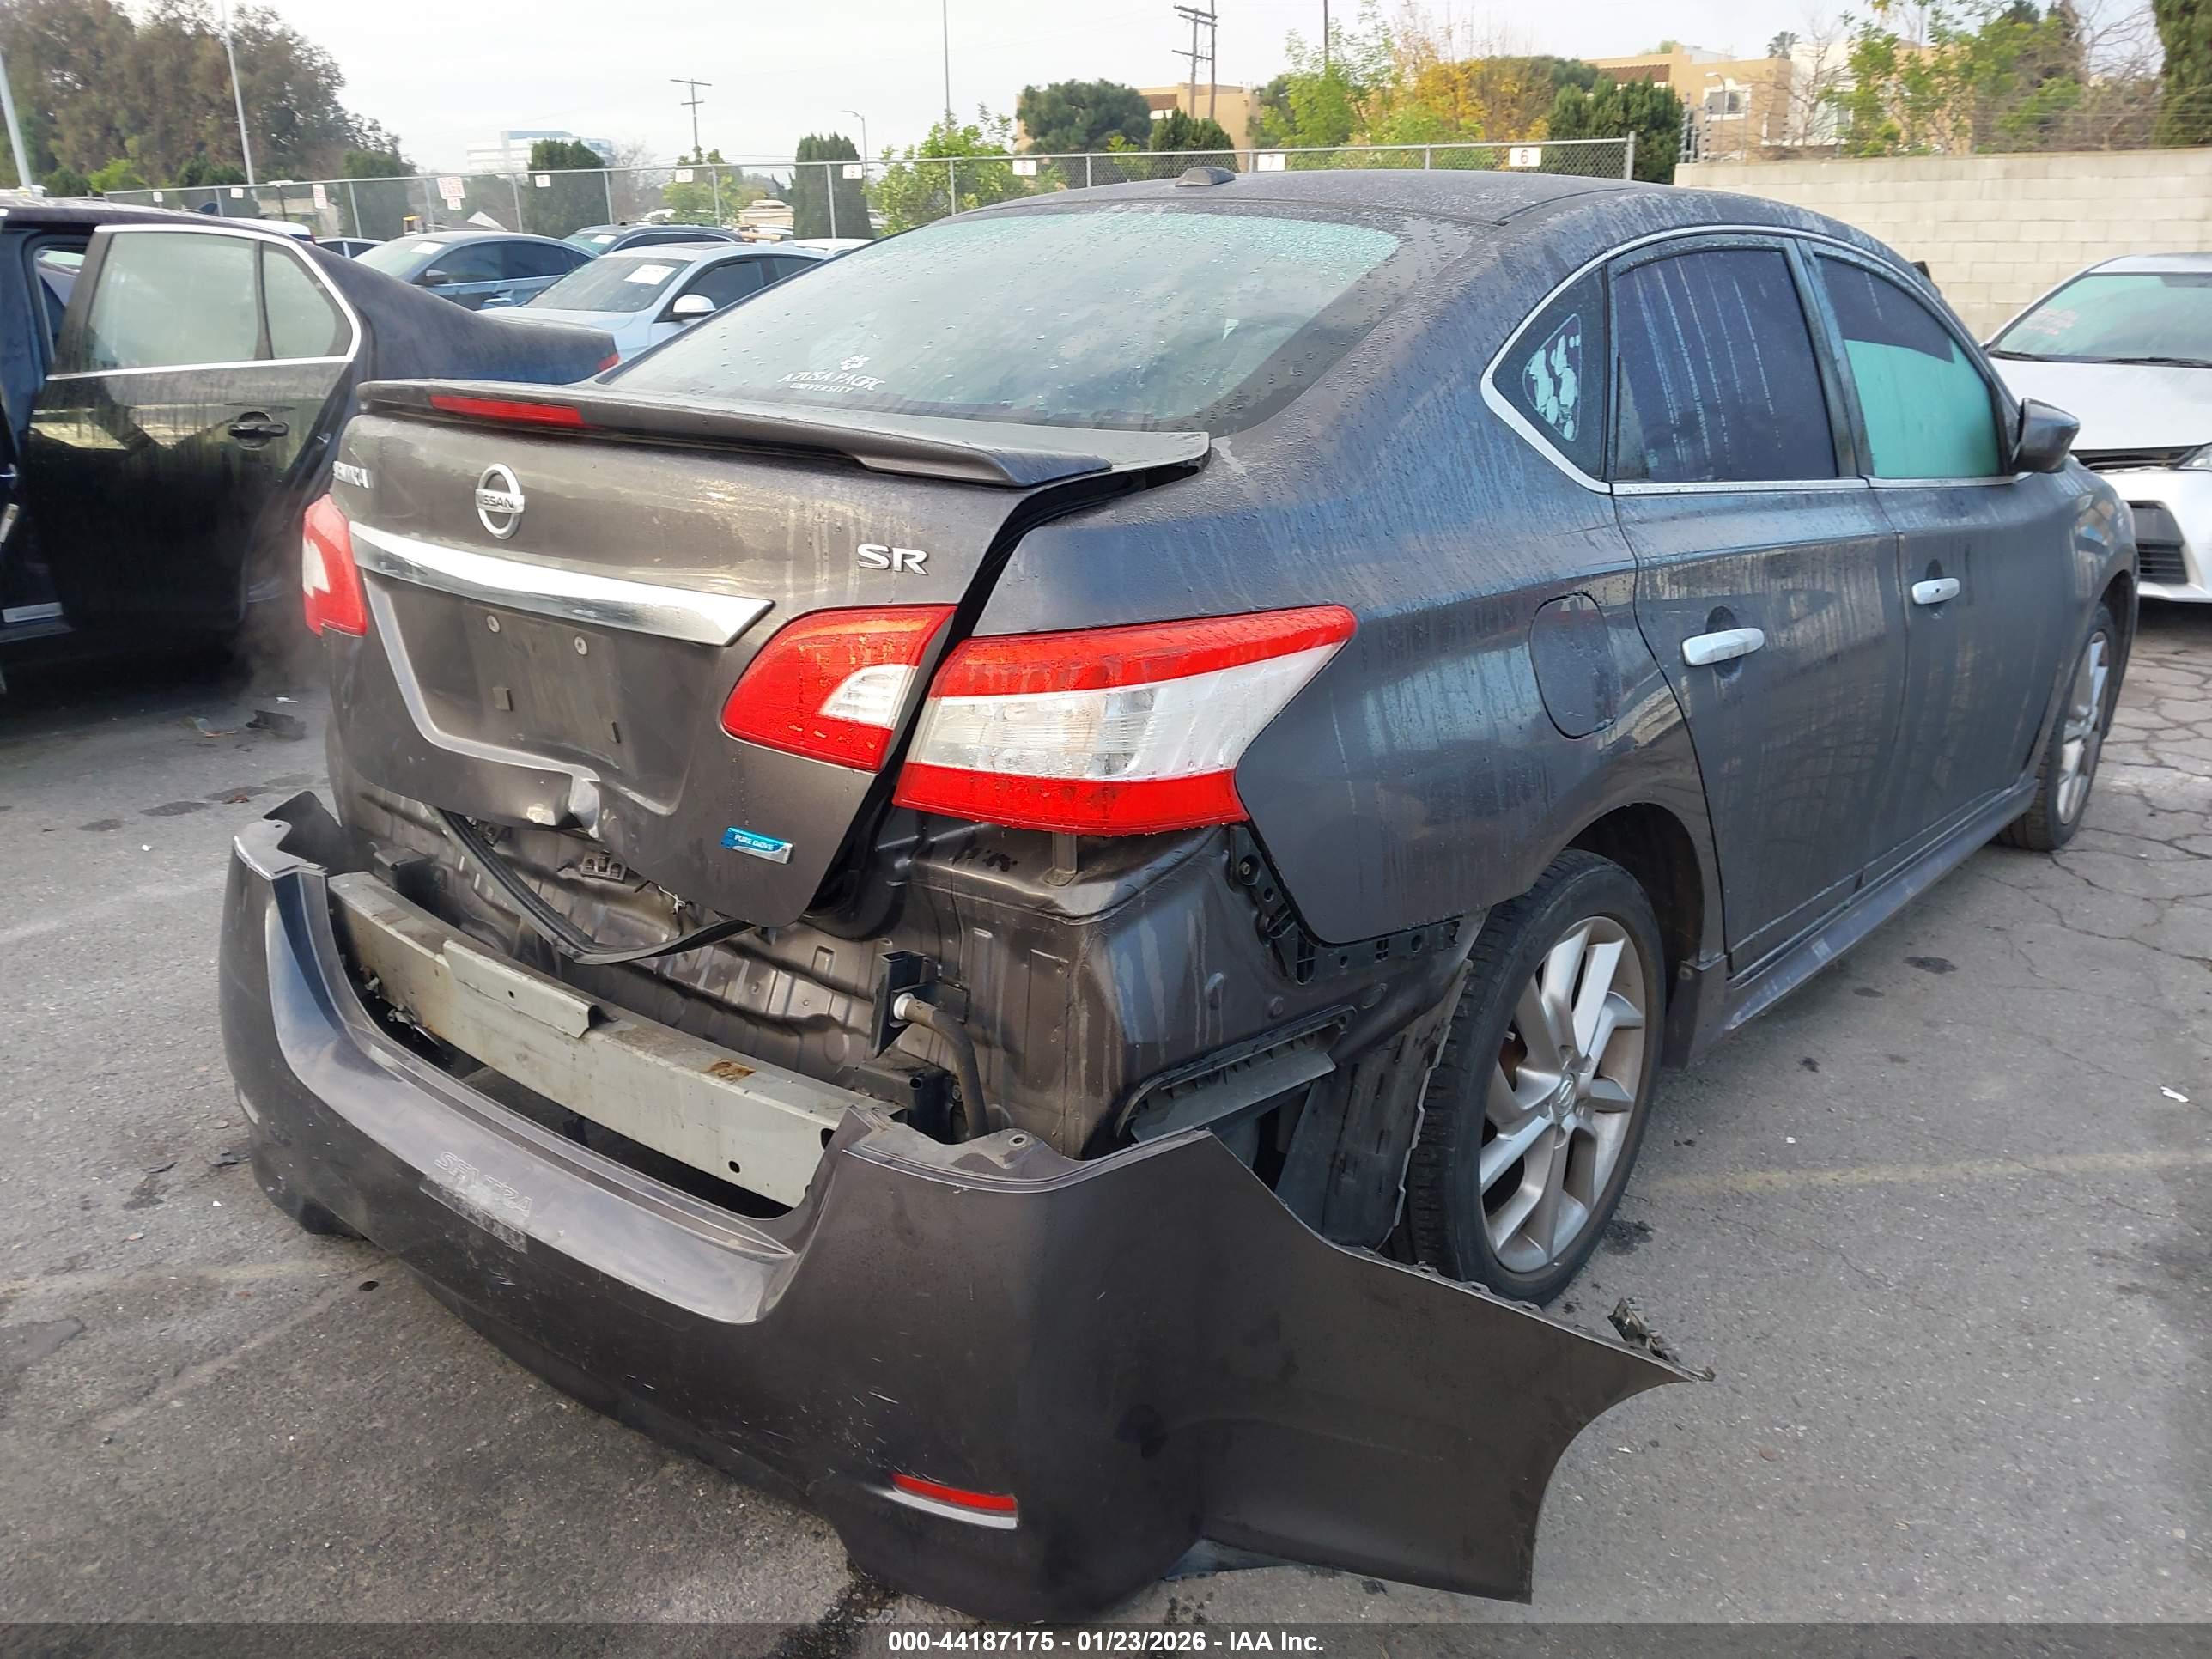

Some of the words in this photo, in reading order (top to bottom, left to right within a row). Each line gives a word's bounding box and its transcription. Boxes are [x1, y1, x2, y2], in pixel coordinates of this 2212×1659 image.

[1520, 149, 1528, 164] 6
[776, 371, 832, 383] AZUSA
[789, 382, 854, 393] UNIVERSITY
[477, 494, 515, 509] SSAN
[857, 544, 928, 575] SR
[734, 834, 753, 845] PURE
